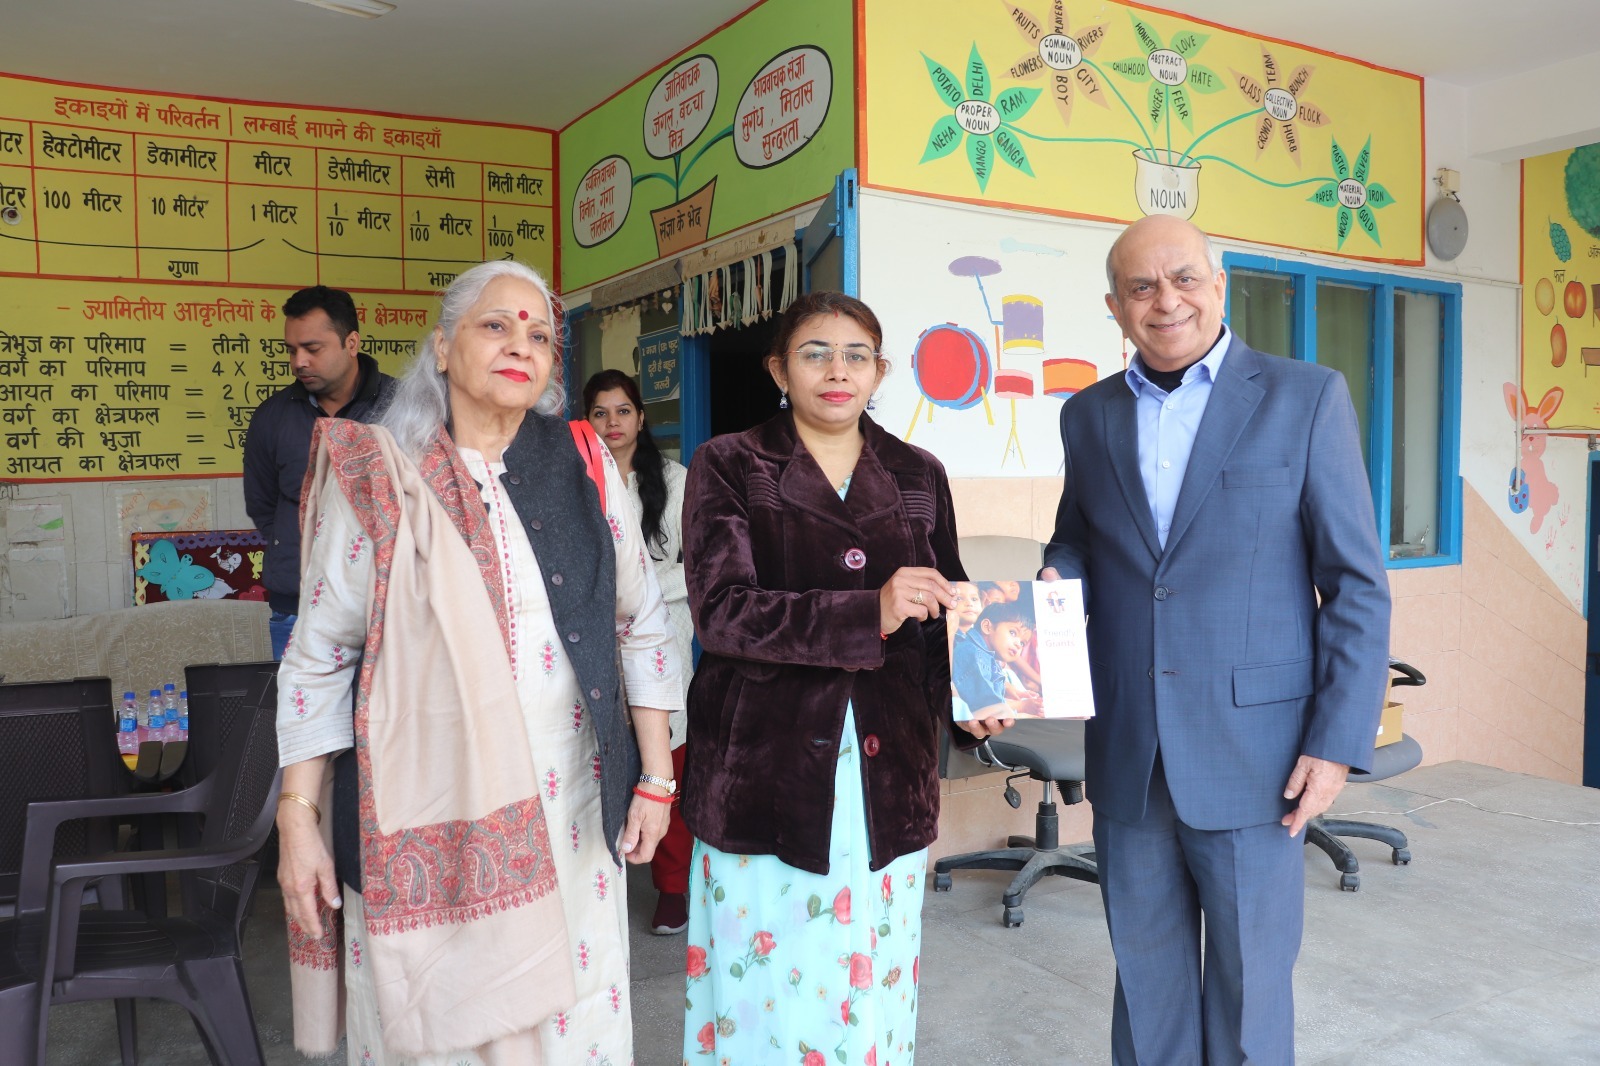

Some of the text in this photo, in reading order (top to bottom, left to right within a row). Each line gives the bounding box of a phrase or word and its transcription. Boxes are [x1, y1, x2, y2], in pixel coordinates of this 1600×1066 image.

[1012, 7, 1041, 40] FRUITS
[1054, 0, 1064, 34] PLAYERS
[1044, 38, 1076, 53] COMMON
[1077, 26, 1104, 52] RIVERS
[1135, 22, 1158, 51] HONESTY
[1176, 35, 1197, 55] LOVE
[1010, 55, 1044, 79] FLOWERS
[1047, 51, 1072, 65] NOUN
[1112, 62, 1146, 76] CHILDHOOD
[1150, 54, 1183, 67] ABSTRACT
[1263, 54, 1277, 85] TEAM
[932, 66, 962, 103] POTATO
[972, 61, 984, 96] DELHI
[1076, 68, 1100, 95] CITY
[1159, 68, 1178, 82] NOUN
[1190, 69, 1213, 88] HATE
[1288, 67, 1309, 96] BUNCH
[780, 80, 814, 117] मिठास
[1000, 90, 1028, 116] RAM
[1055, 75, 1069, 106] BOY
[54, 97, 221, 130] इकाइयों में परिवर्तन
[960, 103, 993, 118] PROPER
[1150, 88, 1164, 123] ANGER
[1172, 89, 1189, 120] FEAR
[1271, 105, 1288, 119] NOUN
[1299, 105, 1321, 125] FLOCK
[243, 115, 298, 140] लम्बाई
[305, 119, 347, 141] मापने
[353, 122, 375, 142] की
[965, 117, 990, 132] NOUN
[1257, 117, 1273, 150] CROWD
[0, 131, 24, 155] टर
[42, 130, 122, 163] हेक्टोमीटर
[931, 125, 957, 152] NEHA
[996, 131, 1025, 169] GANGA
[1282, 123, 1298, 153] HURB
[147, 142, 218, 171] डेकामीटर
[253, 151, 293, 177] मीटर
[975, 140, 987, 179] MANGO
[1332, 144, 1347, 175] PLASTIC
[1355, 149, 1370, 182] SILVER
[328, 156, 391, 185] डेसीमीटर
[425, 165, 456, 189] सेमी
[488, 170, 543, 196] मिली मीटर
[0, 183, 27, 208] टर
[43, 188, 122, 212] 100 मीटर
[1150, 188, 1187, 209] NOUN
[1315, 189, 1334, 203] PAPER
[1338, 184, 1363, 196] MATERIAL
[1344, 194, 1361, 205] NOUN
[1368, 189, 1385, 202] IRON
[152, 195, 208, 219] 10 मीटर
[263, 200, 298, 225] मीटर
[357, 207, 392, 232] मीटर
[440, 213, 473, 237] मीटर
[517, 219, 545, 242] मीटर
[676, 209, 687, 233] के
[1338, 211, 1349, 238] WOOD
[1359, 209, 1374, 232] GOLD
[168, 260, 199, 278] गुणा
[83, 295, 166, 322] ज्यामितीय
[173, 297, 254, 328] आकृतियों
[261, 298, 276, 323] के
[356, 302, 368, 325] वं
[374, 302, 428, 328] क्षेत्रफल
[50, 336, 75, 354] का
[84, 332, 146, 357] परिमाप
[260, 338, 290, 359] भुज
[361, 334, 417, 357] योगफल
[0, 354, 29, 378] वर्ग
[40, 360, 66, 377] का
[85, 356, 146, 379] परिमाप
[211, 361, 225, 377] 4
[260, 360, 291, 381] भुज
[0, 384, 54, 402] आयत
[71, 384, 98, 401] का
[114, 380, 171, 403] परिमाप
[222, 384, 235, 401] 2
[2, 403, 36, 426] वर्ग
[52, 407, 79, 425] का
[95, 403, 160, 427] क्षेत्रफल
[5, 426, 41, 451] वर्ग
[56, 427, 85, 450] की
[100, 430, 142, 452] भुजा
[6, 456, 63, 475] आयत
[79, 455, 105, 473] का
[118, 449, 183, 475] क्षेत्रफल
